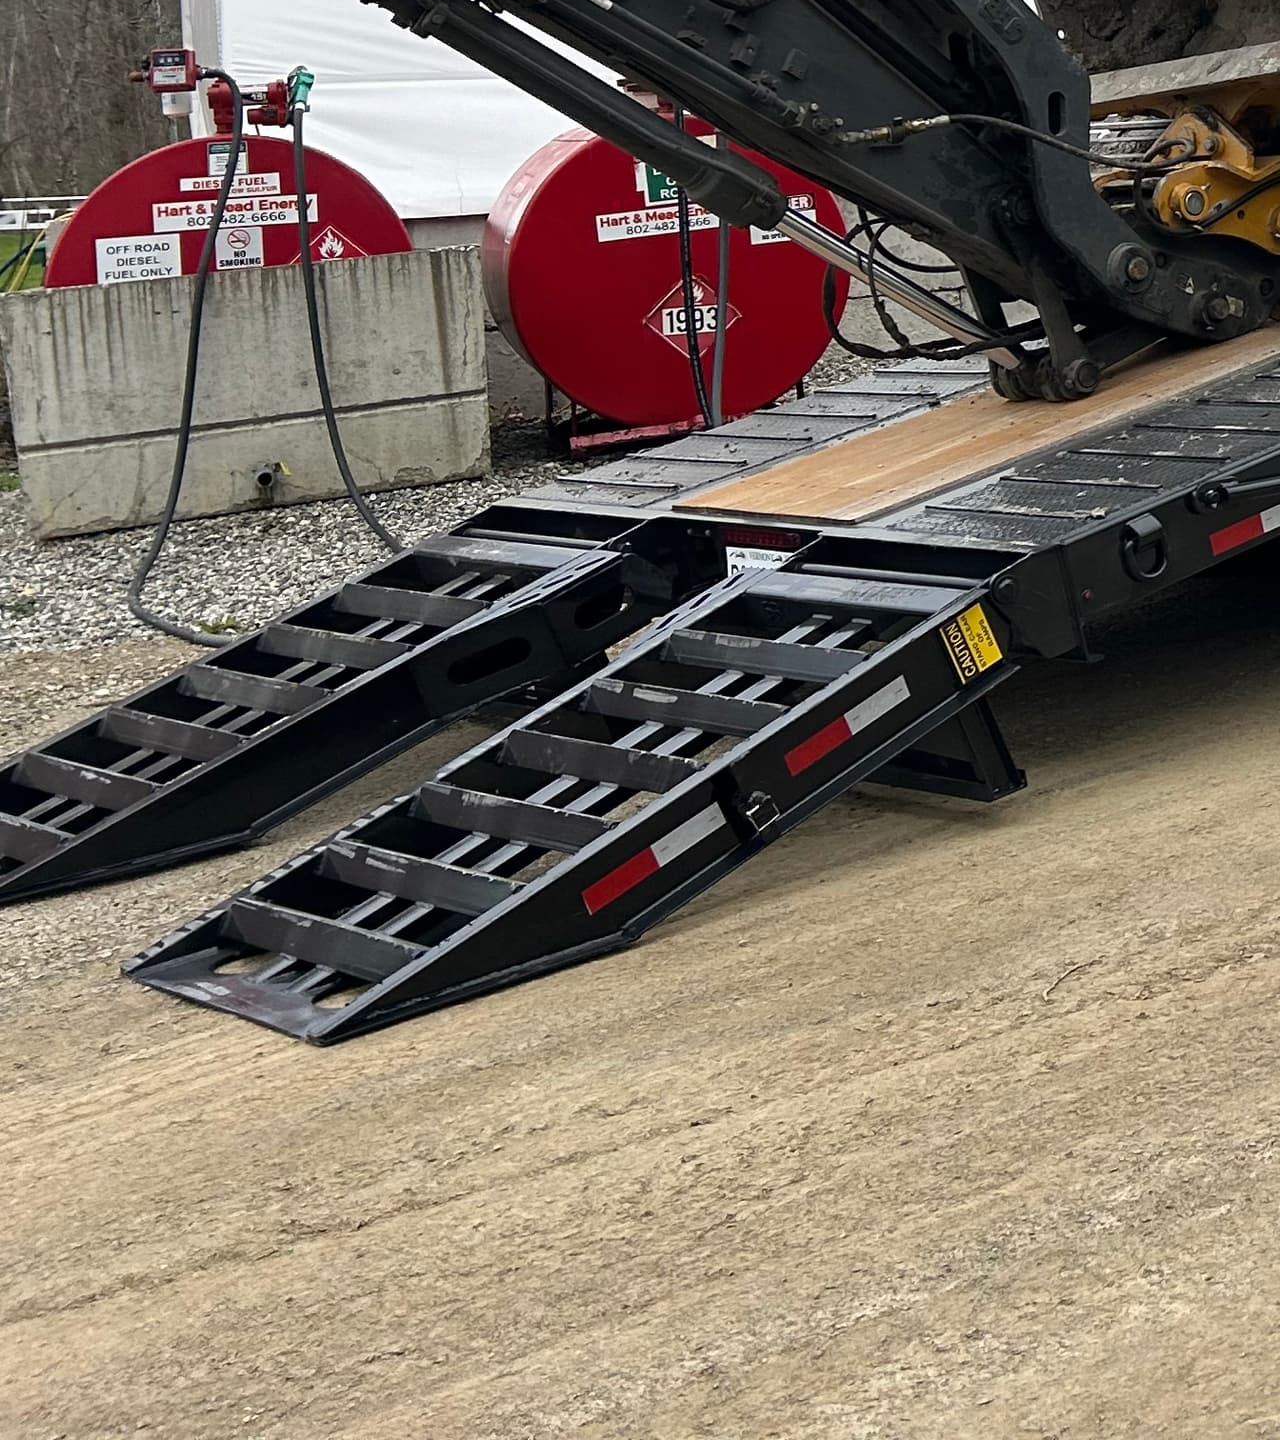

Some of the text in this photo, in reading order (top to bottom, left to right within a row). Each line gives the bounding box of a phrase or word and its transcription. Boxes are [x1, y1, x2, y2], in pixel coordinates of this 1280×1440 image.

[193, 177, 268, 189] DIES FUEL
[157, 205, 192, 218] Hart
[196, 203, 207, 215] &
[259, 198, 314, 212] Enery
[187, 211, 287, 227] 802482-6666
[600, 215, 631, 228] Hart
[633, 213, 643, 224] &
[106, 242, 171, 255] OFF ROAD
[234, 250, 246, 258] NO
[116, 256, 161, 267] DIESEL
[219, 257, 261, 267] SMOKING
[105, 267, 173, 280] FUEL ONLY
[946, 622, 976, 677] CAUTION
[972, 643, 987, 667] STAND
